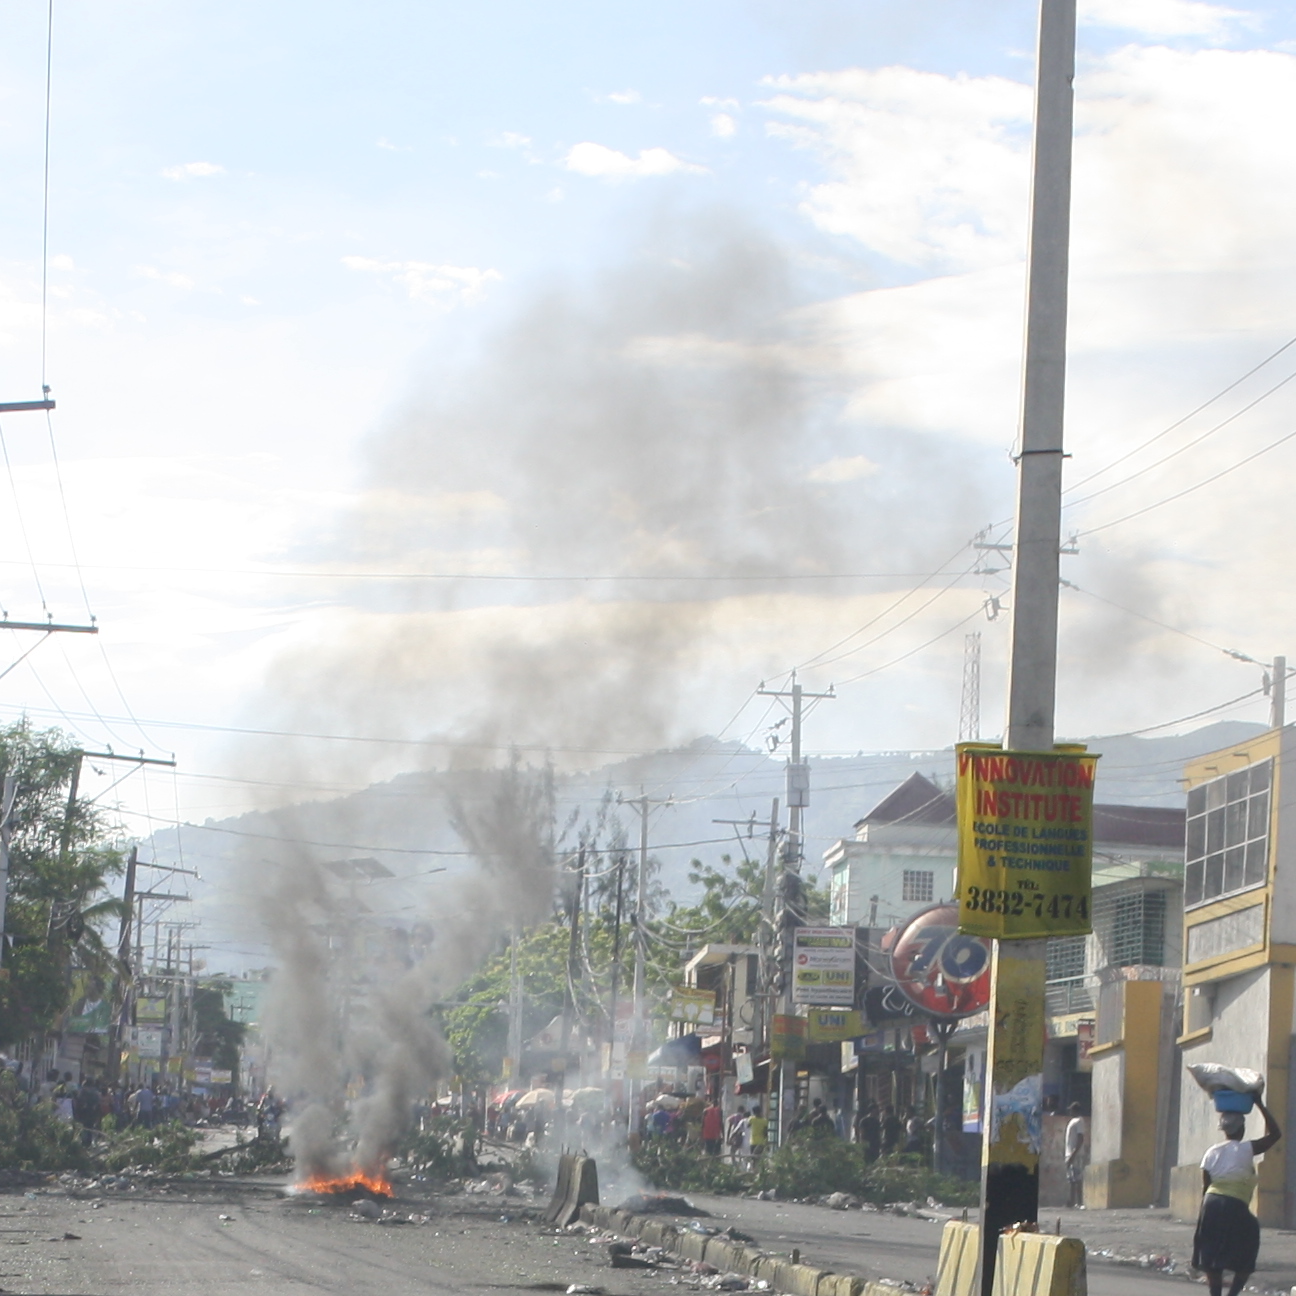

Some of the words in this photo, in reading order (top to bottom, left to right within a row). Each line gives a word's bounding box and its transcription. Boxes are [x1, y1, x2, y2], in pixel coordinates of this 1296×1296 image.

[973, 755, 1094, 789] INNOVATION
[976, 790, 1083, 822] INSTITUTE
[973, 821, 1010, 835] ECOLE
[1013, 826, 1028, 838] DE
[1032, 828, 1088, 841] LANGUES
[974, 838, 1086, 857] PROFESSIONNELLE
[987, 855, 996, 867] &
[1000, 857, 1070, 871] TECHNIQUE
[966, 886, 1089, 919] 3832-7474
[907, 926, 989, 983] 76
[819, 1014, 847, 1026] UNI
